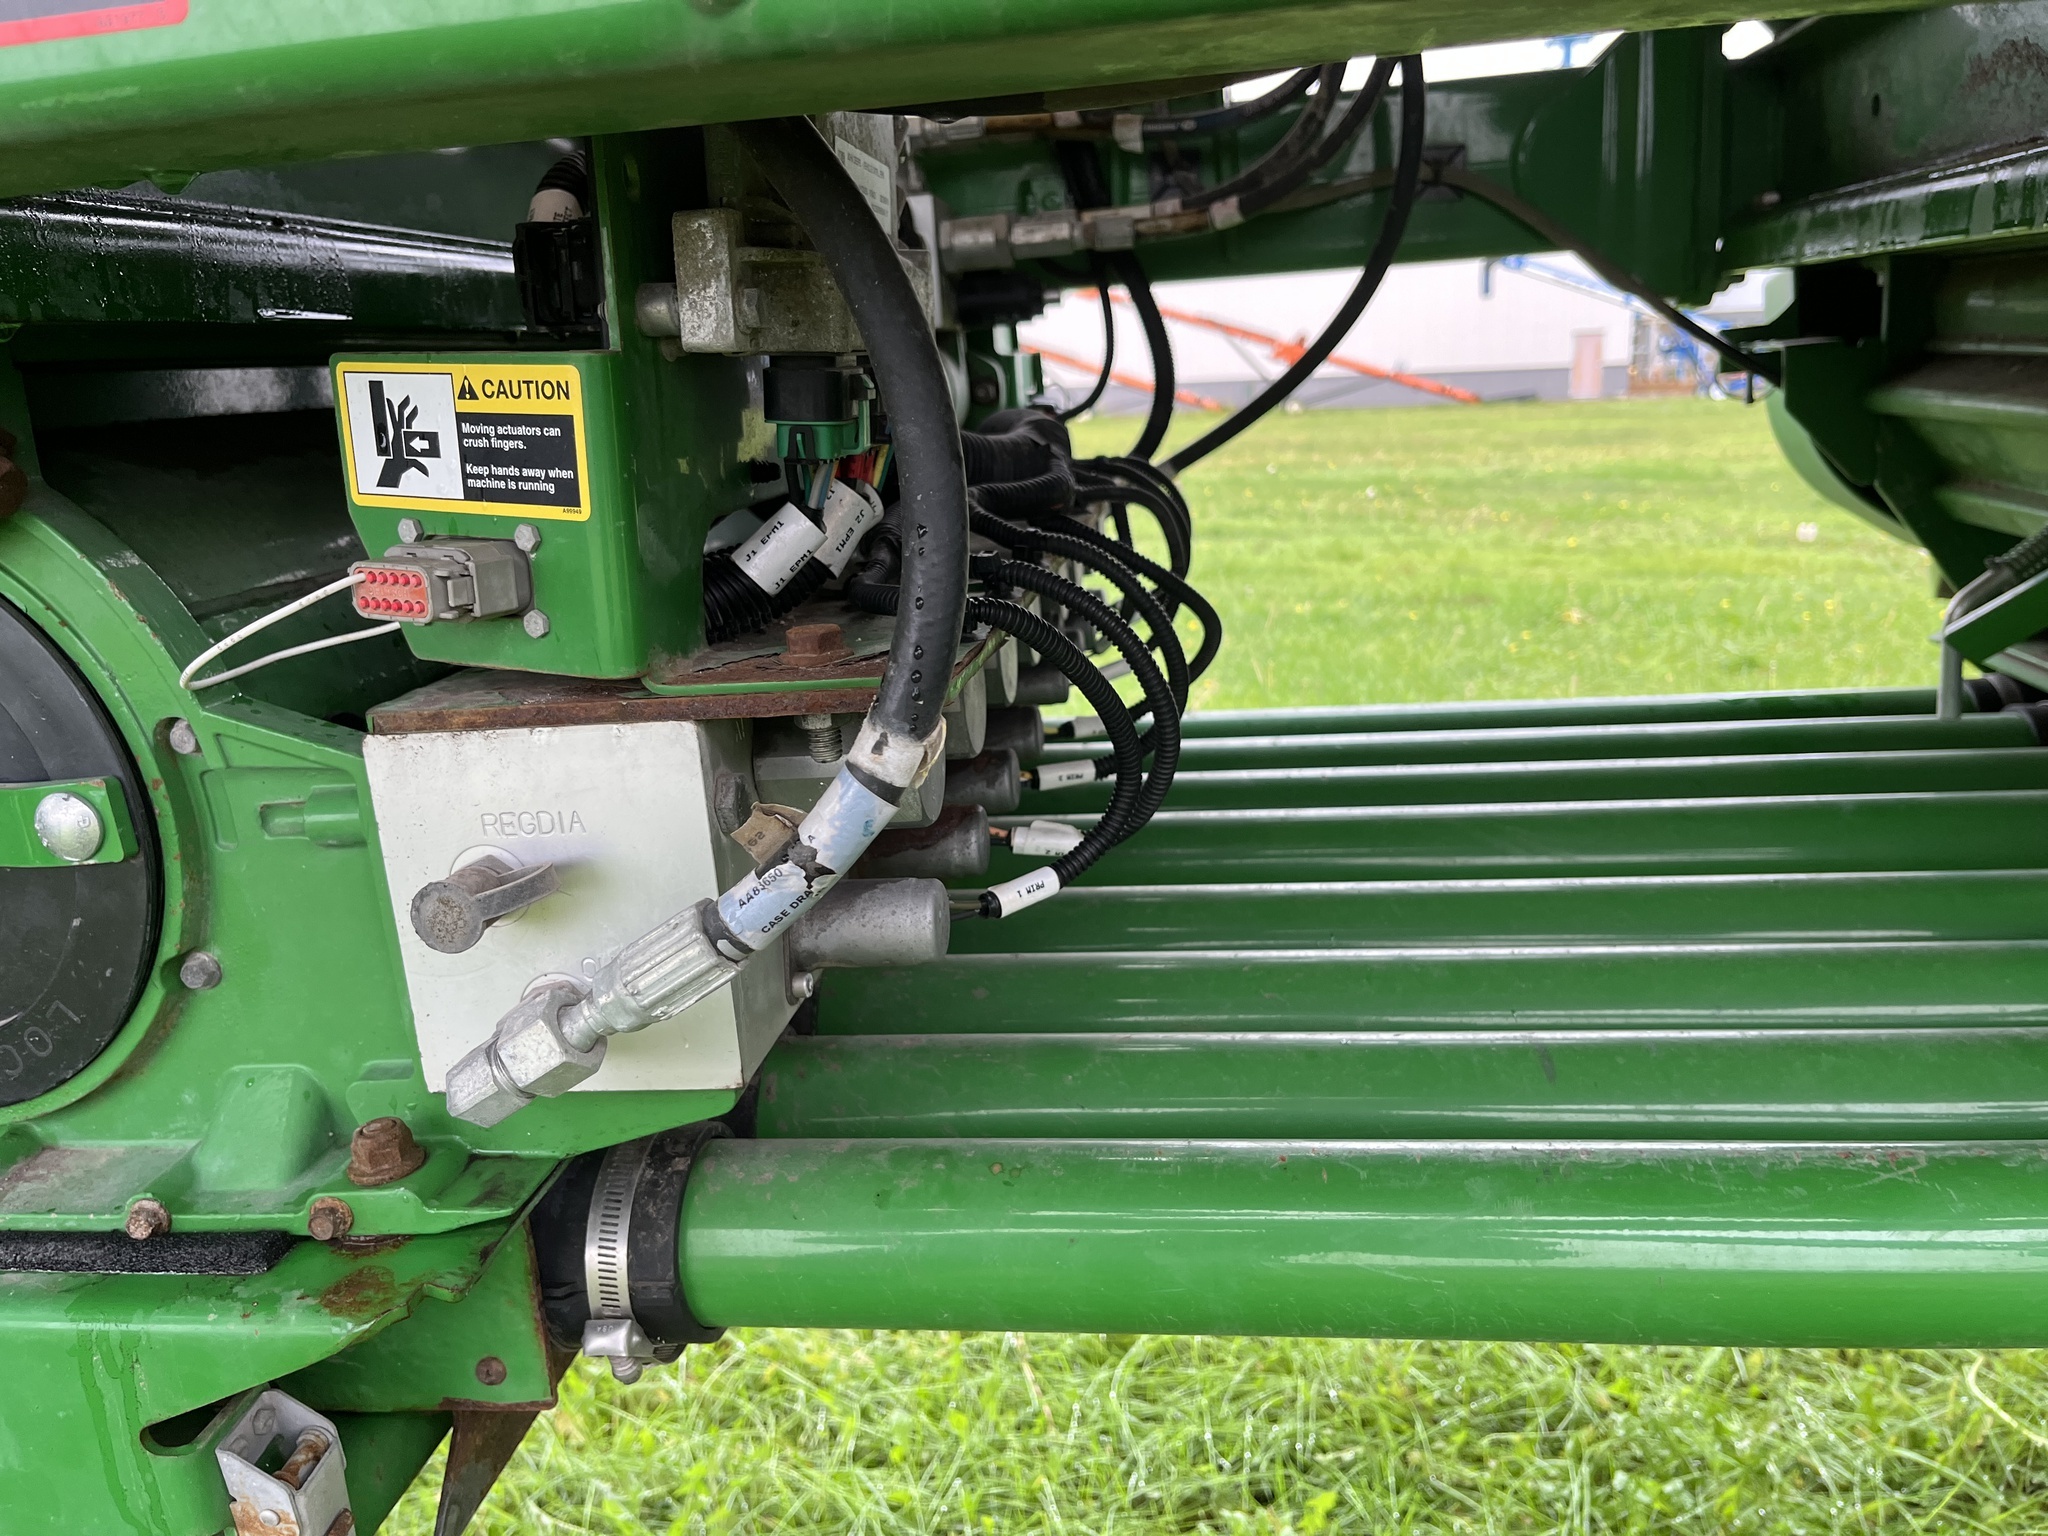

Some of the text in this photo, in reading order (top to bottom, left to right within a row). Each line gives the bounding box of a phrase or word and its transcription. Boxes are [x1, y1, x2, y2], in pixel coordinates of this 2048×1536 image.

[481, 379, 570, 400] CAUTION
[461, 422, 561, 437] Moving actuators can
[463, 438, 527, 450] crush fingers.
[466, 463, 574, 480] Keep hands away when
[467, 479, 555, 493] machine is running
[746, 521, 784, 562] J1 EPM1
[836, 510, 865, 553] J2 EPM1
[775, 549, 813, 589] J1 EPM1
[481, 810, 587, 838] REGDIA
[1017, 881, 1045, 898] PRIM 1
[761, 887, 825, 933] CASE DRA
